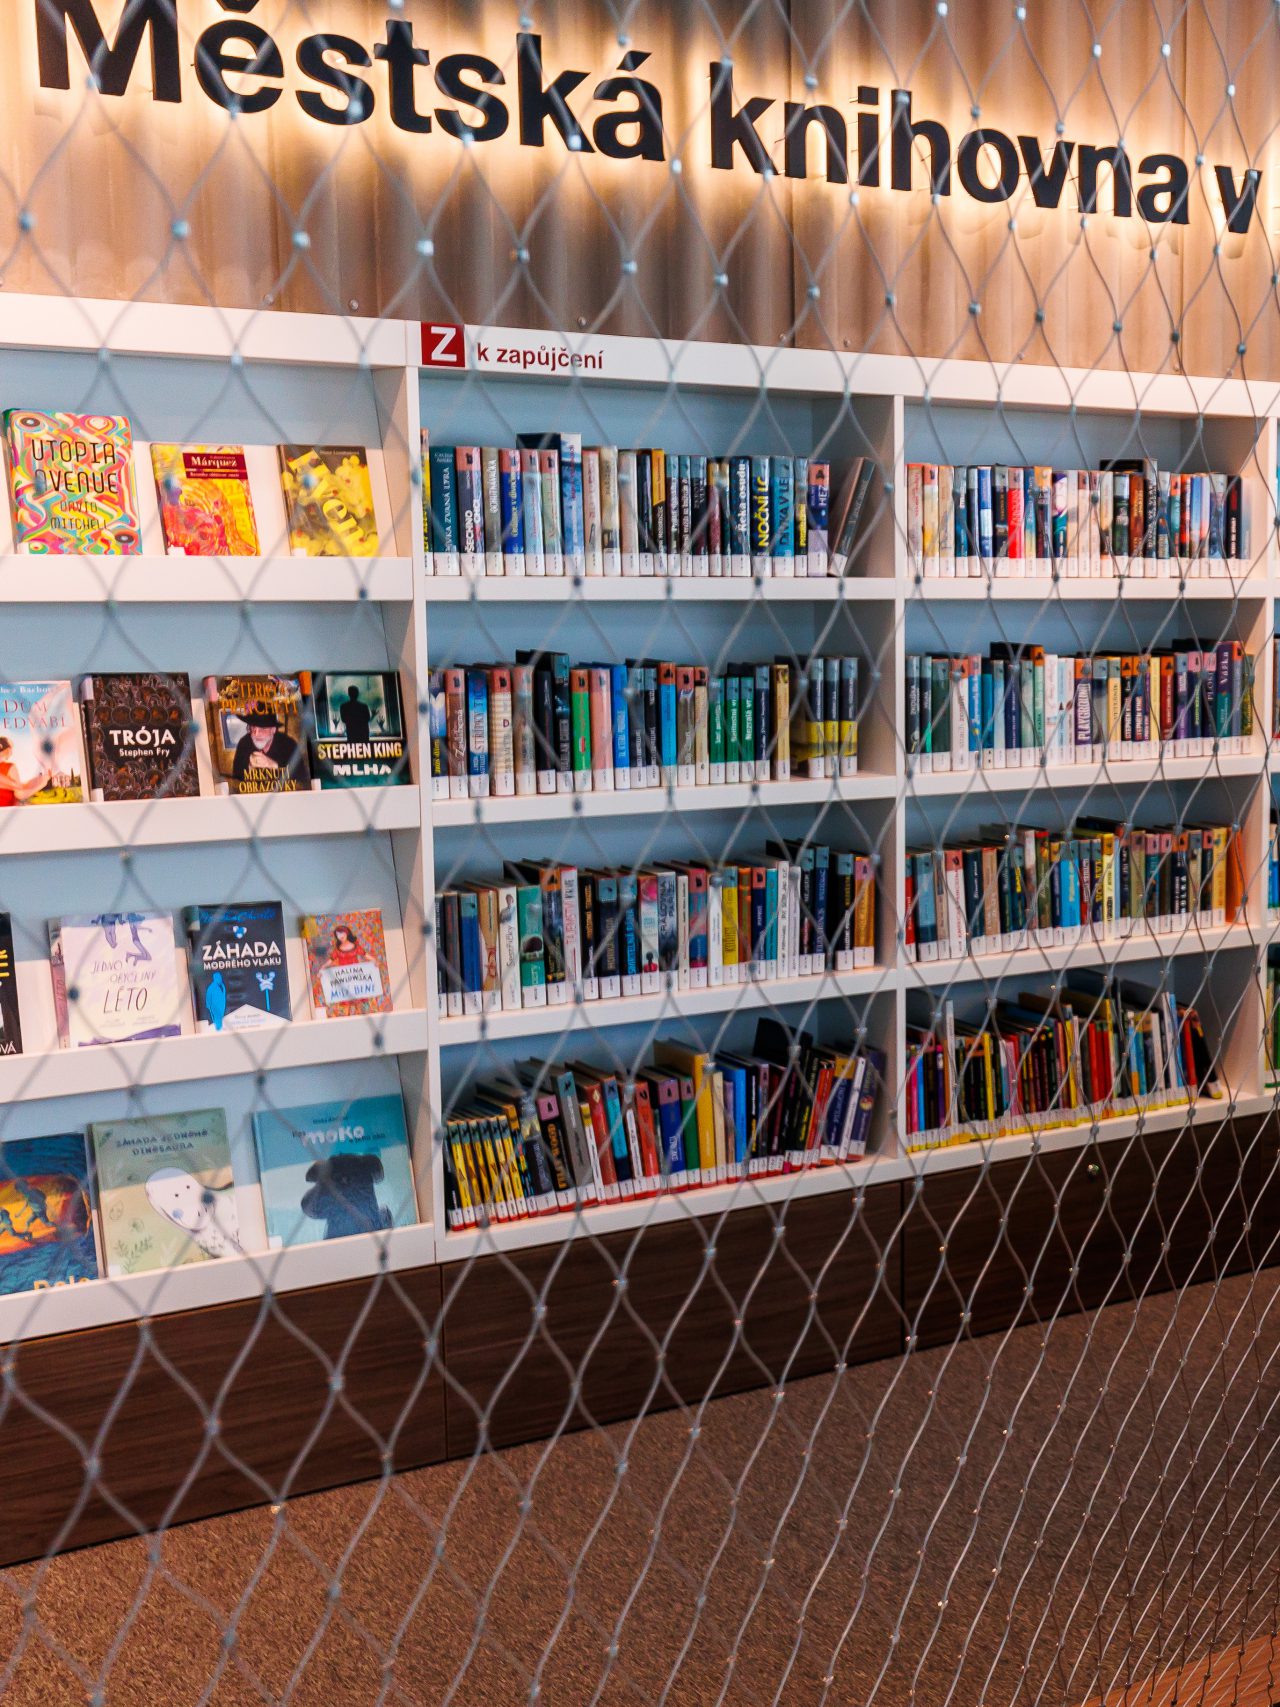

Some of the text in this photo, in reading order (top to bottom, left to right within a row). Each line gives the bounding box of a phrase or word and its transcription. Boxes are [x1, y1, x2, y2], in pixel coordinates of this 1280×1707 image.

[31, 0, 666, 162] Městská
[709, 61, 1191, 225] knihovna
[1214, 164, 1263, 234] v
[430, 325, 458, 363] Z
[477, 342, 606, 372] k zapůjčení
[32, 439, 116, 465] UTOPIA
[191, 455, 238, 469] Márquez
[34, 469, 119, 495] AVENUE
[464, 510, 475, 553] ŠECHNO
[753, 495, 769, 547] NOČNÍ
[1076, 683, 1091, 741] PLAYGROUND
[109, 725, 177, 747] TRÓJA
[1124, 715, 1132, 740] STEPHEN
[1135, 714, 1143, 740] STEPHEN
[119, 747, 171, 758] Stephen Fry
[317, 740, 403, 761] STEPHEN KING
[332, 763, 392, 777] MLHA
[238, 779, 298, 794] OBRAZOVKY
[202, 940, 281, 962] ZÁHADA
[203, 956, 282, 971] MODRÉHO VLAKU
[335, 967, 365, 978] HALINA
[103, 986, 149, 1014] LÉTO
[115, 1138, 158, 1149] ZÁHADA
[132, 1142, 195, 1156] DINOSAURA
